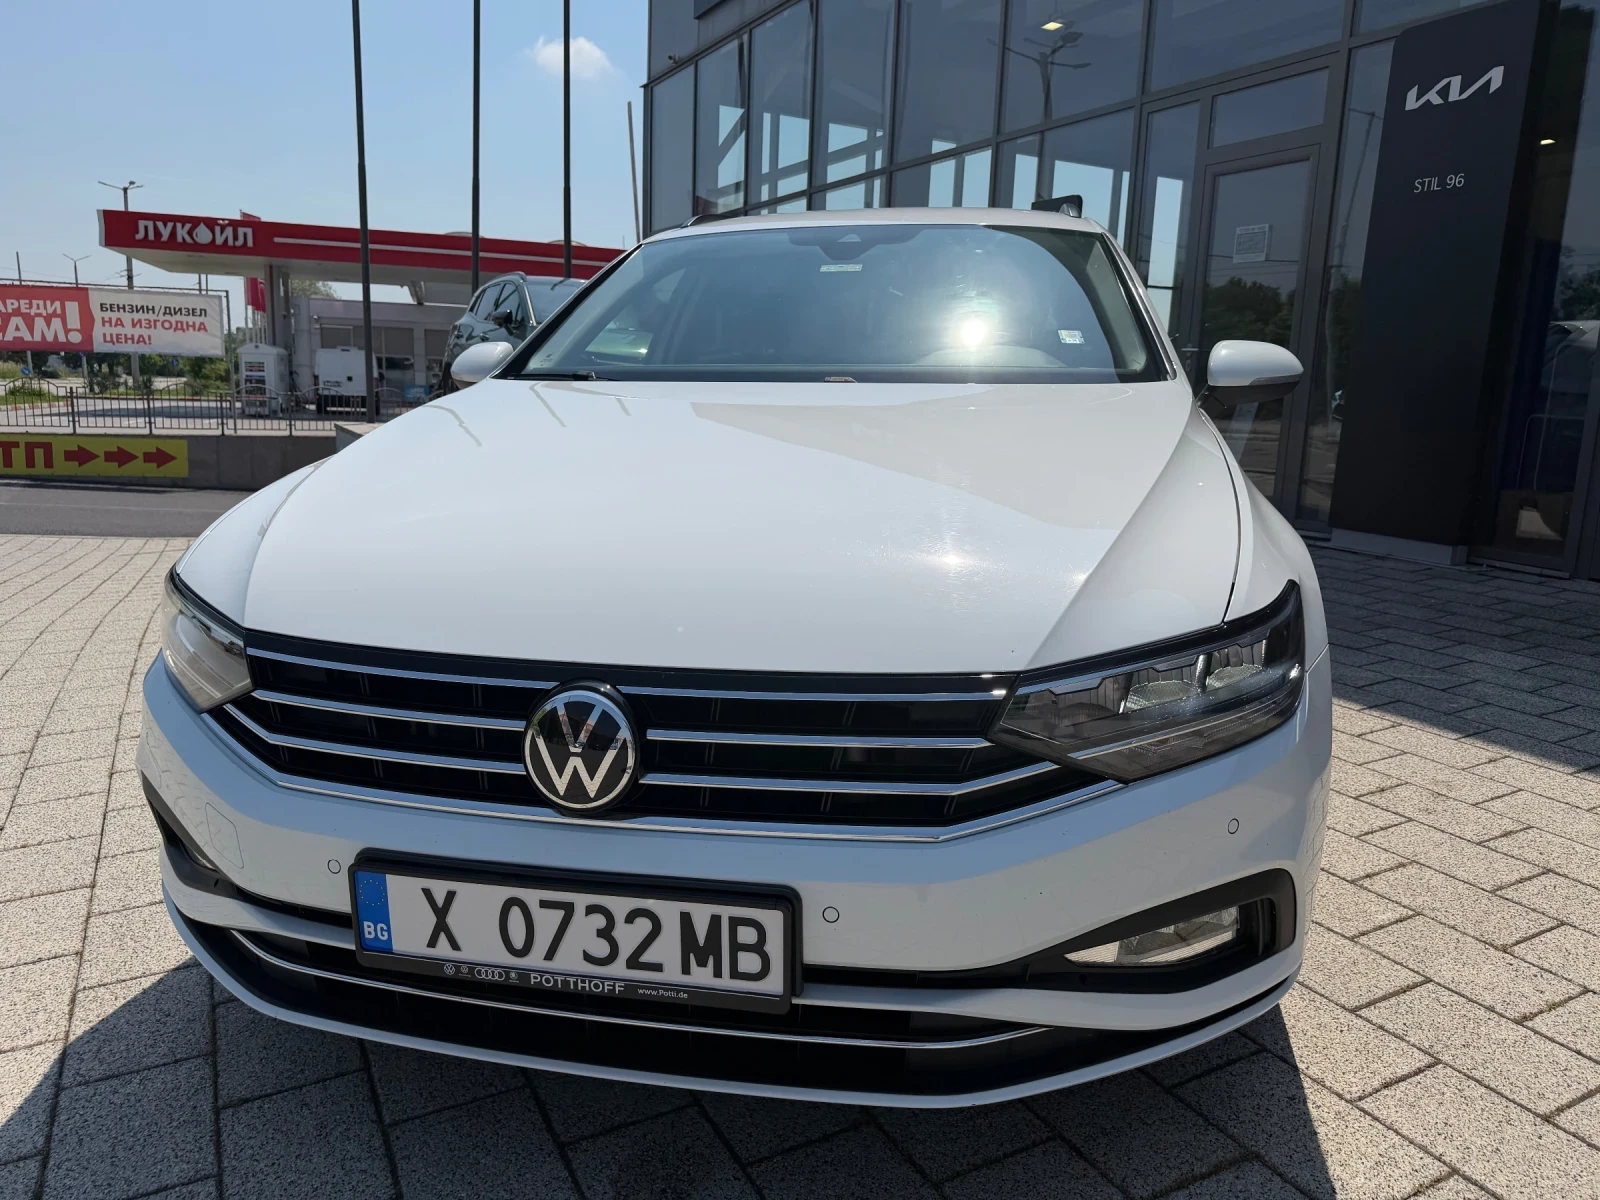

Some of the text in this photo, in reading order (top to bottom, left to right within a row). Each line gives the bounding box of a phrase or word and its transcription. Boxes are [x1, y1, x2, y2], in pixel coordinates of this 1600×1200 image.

[1405, 65, 1504, 110] KIA
[1413, 173, 1465, 193] STIL 96
[100, 302, 208, 318] БЕНЗИН/ДИЗЕЛ
[0, 301, 82, 344] АМ!
[102, 316, 208, 333] НА ИЗГОДНА
[103, 332, 152, 346] ЦЕНА!
[363, 921, 389, 941] BG
[530, 973, 625, 994] POTTHOFF
[637, 987, 689, 999] www.Potti.de
